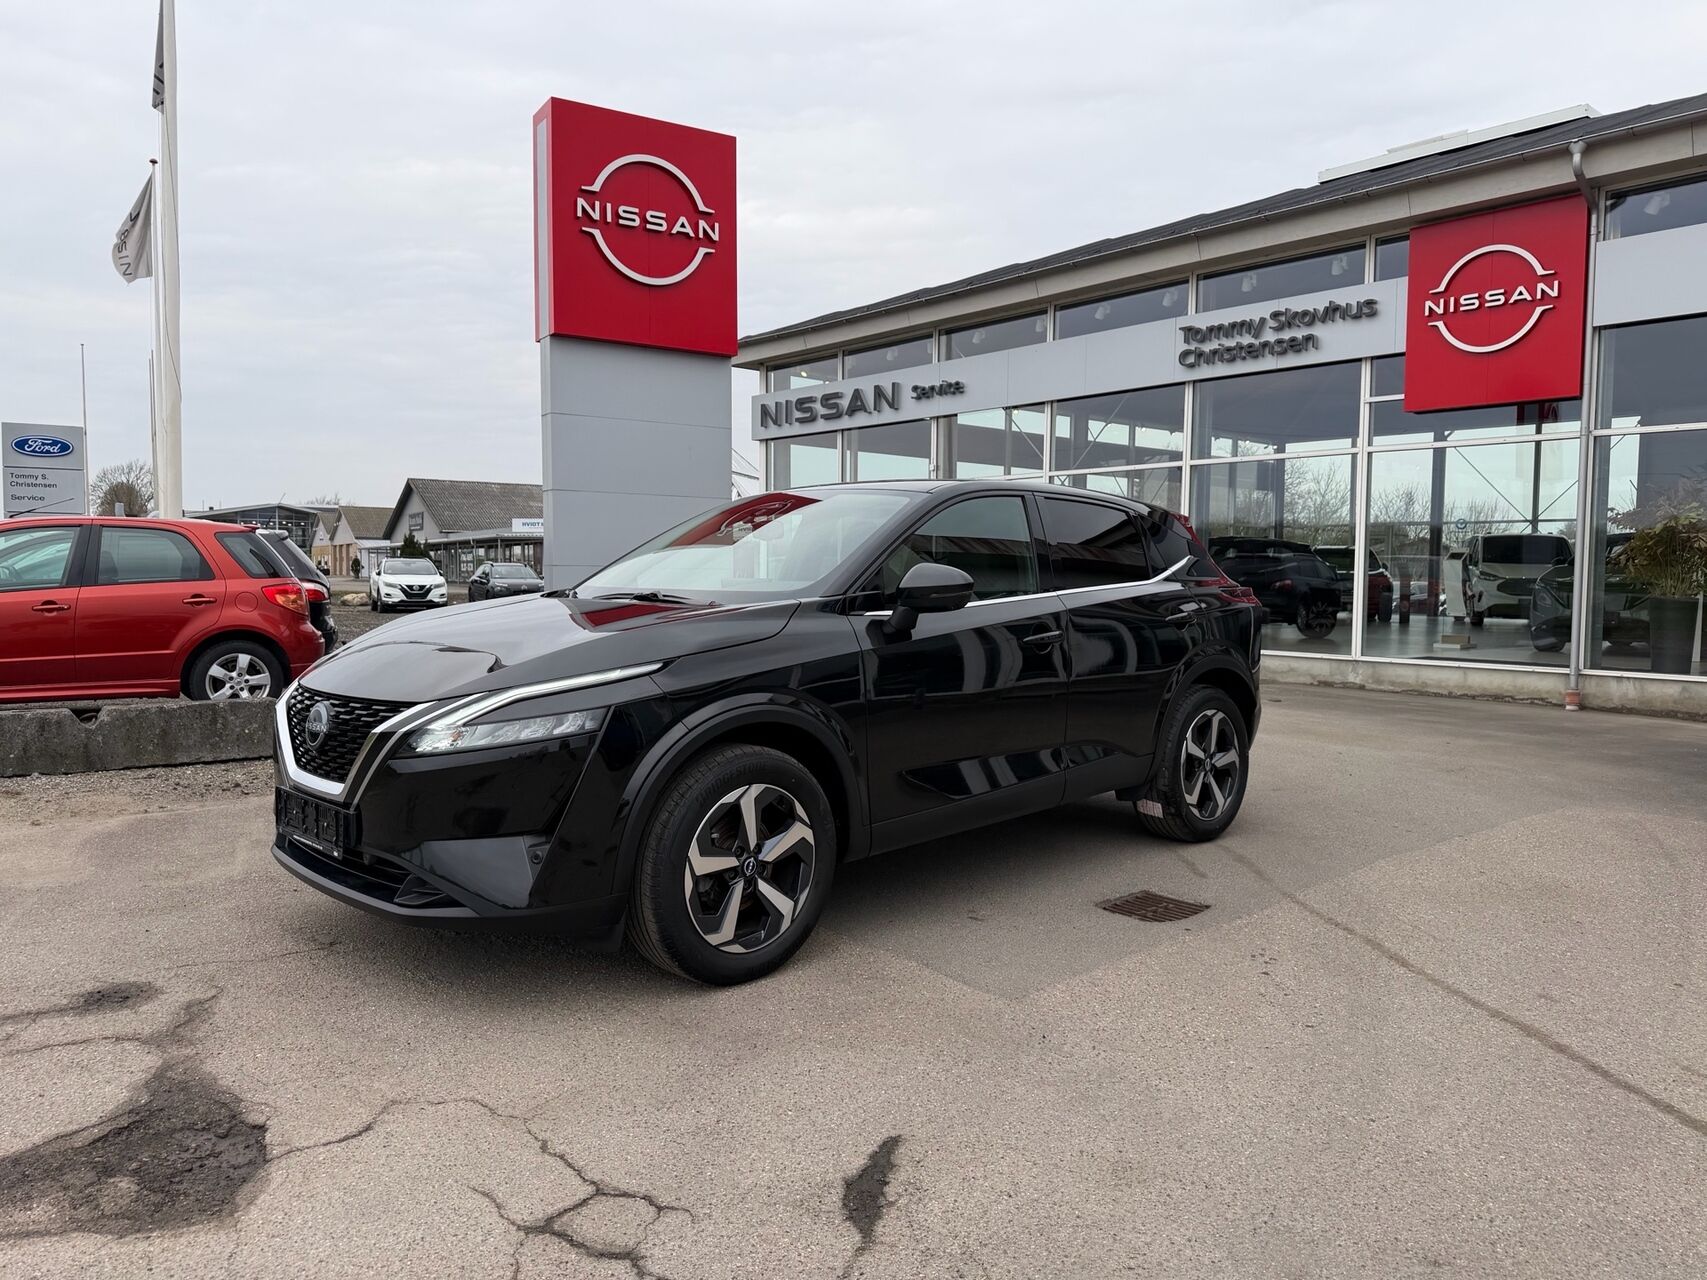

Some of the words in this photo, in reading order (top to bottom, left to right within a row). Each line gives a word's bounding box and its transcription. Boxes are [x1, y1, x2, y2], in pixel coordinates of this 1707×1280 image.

[576, 197, 720, 242] NISSAN
[1424, 279, 1559, 316] NISSAN
[1179, 316, 1266, 345] Tommy
[1269, 298, 1378, 331] Skovhus
[1178, 332, 1318, 368] Christensen
[760, 381, 900, 429] NISSAN
[910, 379, 965, 400] Service
[24, 438, 61, 453] Ford
[9, 472, 39, 481] Tommy
[9, 480, 58, 489] Christensen
[10, 493, 46, 502] Service
